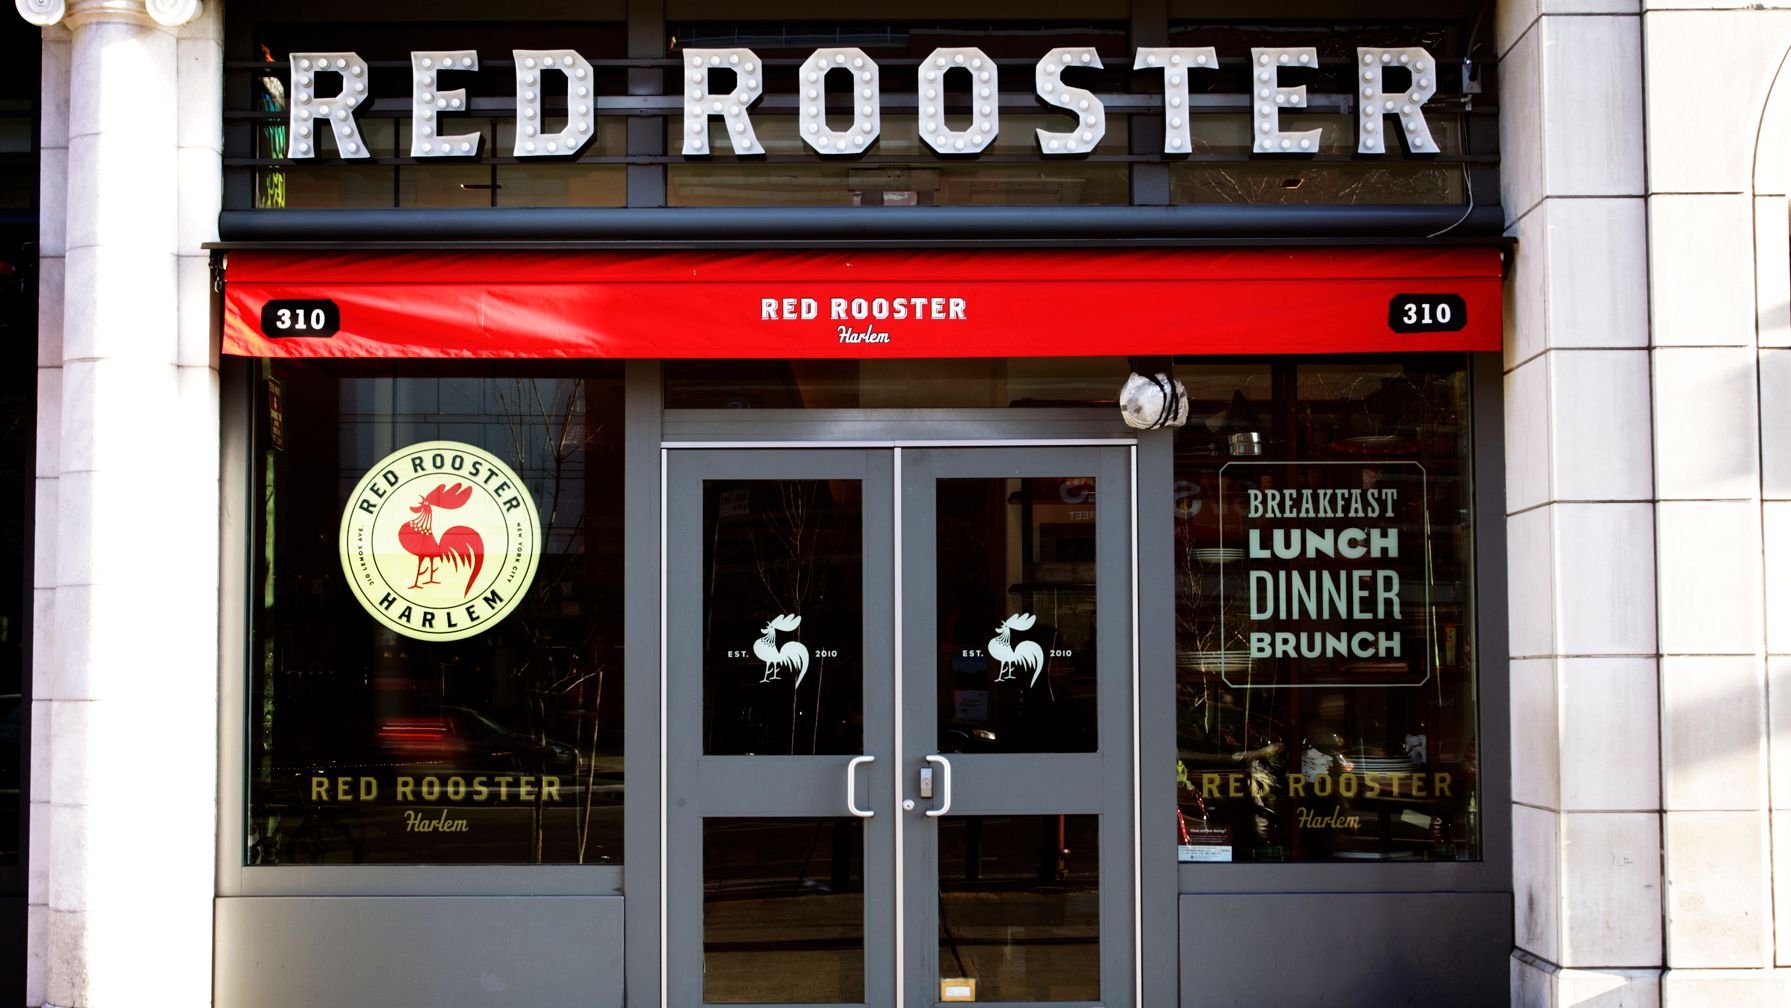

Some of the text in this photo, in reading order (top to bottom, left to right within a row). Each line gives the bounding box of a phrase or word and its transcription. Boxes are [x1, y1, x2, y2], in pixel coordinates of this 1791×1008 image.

[287, 47, 1441, 158] RED ROOSTER
[275, 307, 327, 330] 310
[761, 298, 967, 320] RED ROOSTER
[1402, 302, 1452, 325] 310
[837, 324, 890, 344] Harlem
[358, 453, 521, 515] RED ROOSTER
[1248, 488, 1398, 518] BREAKFAST
[515, 542, 523, 563] YORK
[1249, 527, 1399, 560] LUNCH
[358, 545, 368, 572] LENOX
[364, 573, 375, 586] 310
[507, 566, 518, 583] CITY
[1250, 569, 1403, 621] DINNER
[379, 588, 504, 629] HARLEM
[728, 650, 838, 658] EST. 2010
[962, 649, 1072, 658] EST. 2010
[1250, 631, 1401, 659] BRUNCH
[311, 776, 561, 801] RED ROOSTER
[1202, 772, 1453, 798] RED ROOSTER
[404, 809, 469, 832] Harlem
[1296, 805, 1361, 829] Harlem
